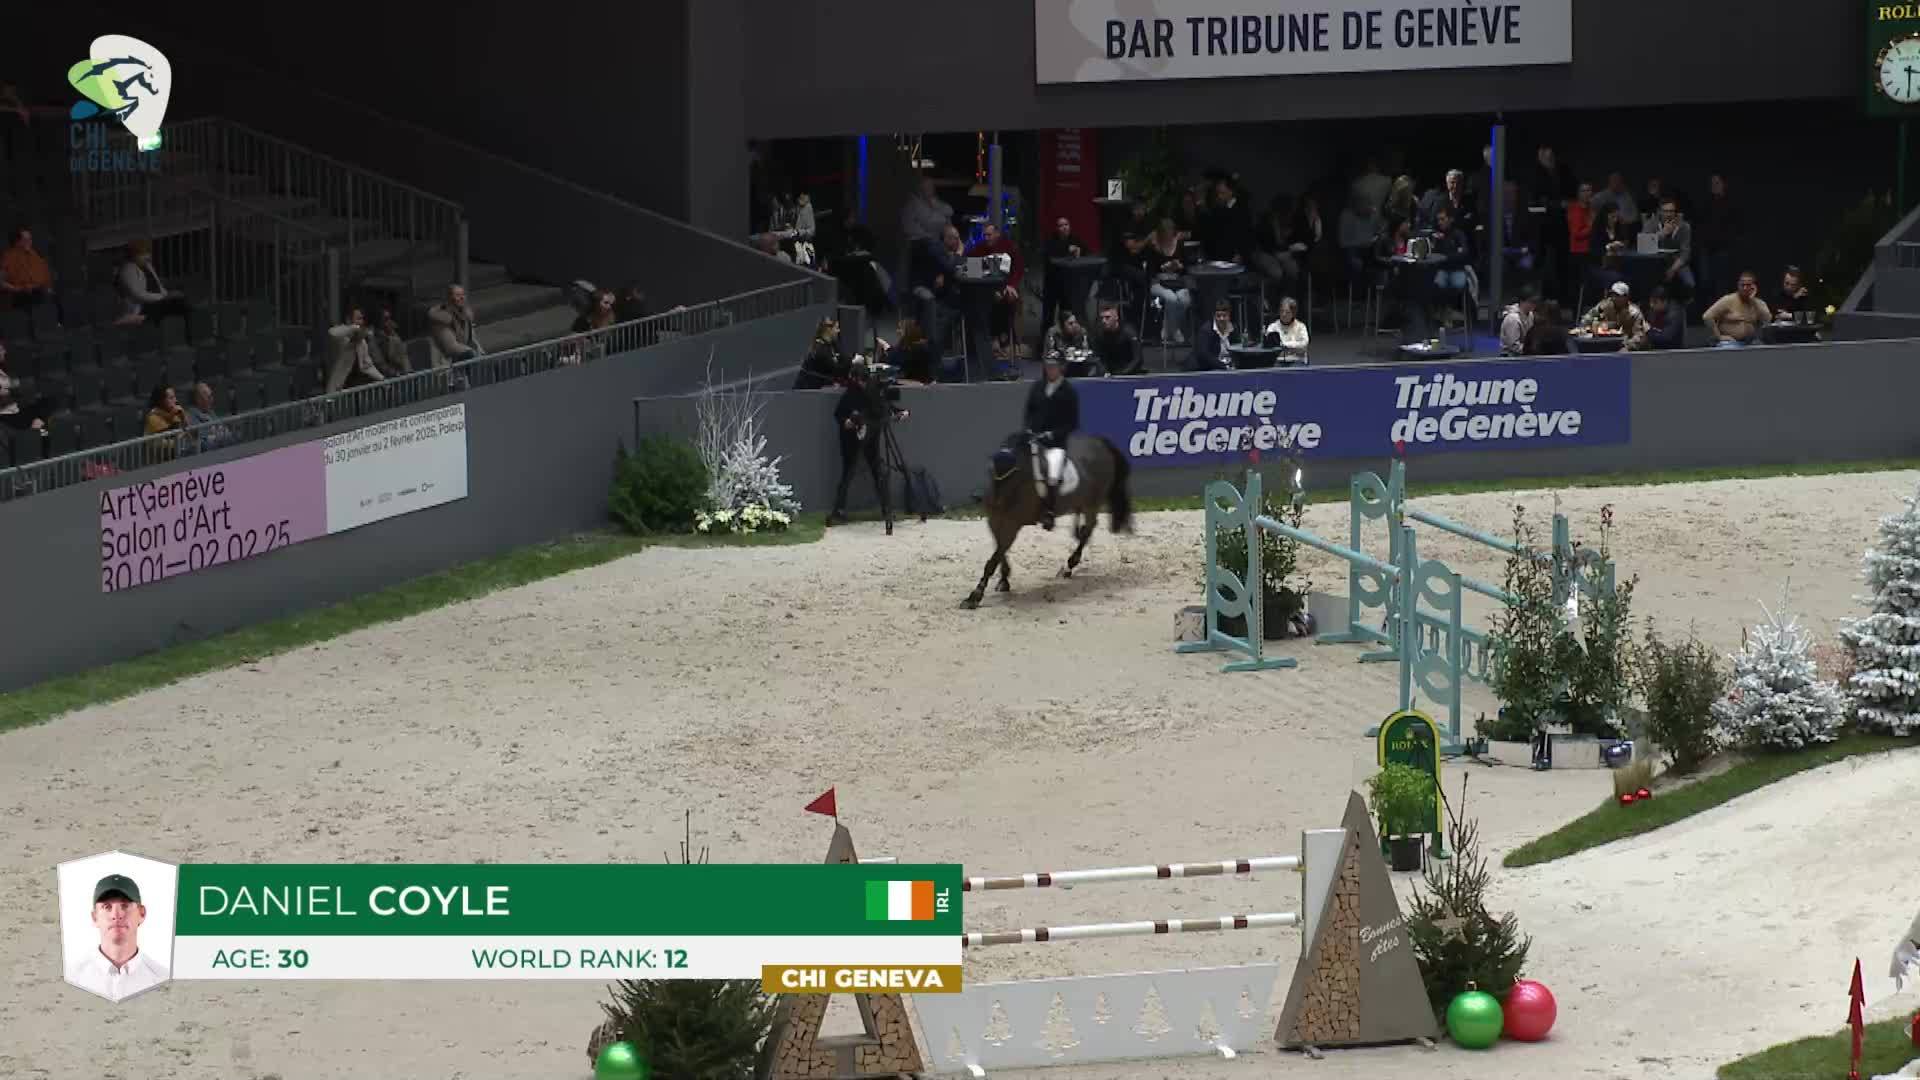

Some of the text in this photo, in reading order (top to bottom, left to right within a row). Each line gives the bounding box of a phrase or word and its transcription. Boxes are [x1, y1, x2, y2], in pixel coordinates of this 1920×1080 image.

[1105, 0, 1521, 59] BAR TRIBUNE DE GENÈVE
[1879, 4, 1920, 20] ROL
[1133, 387, 1276, 422] Tribune
[1395, 373, 1538, 408] Tribune
[335, 449, 346, 463] 30
[383, 437, 391, 449] 2
[102, 521, 165, 562] Salon
